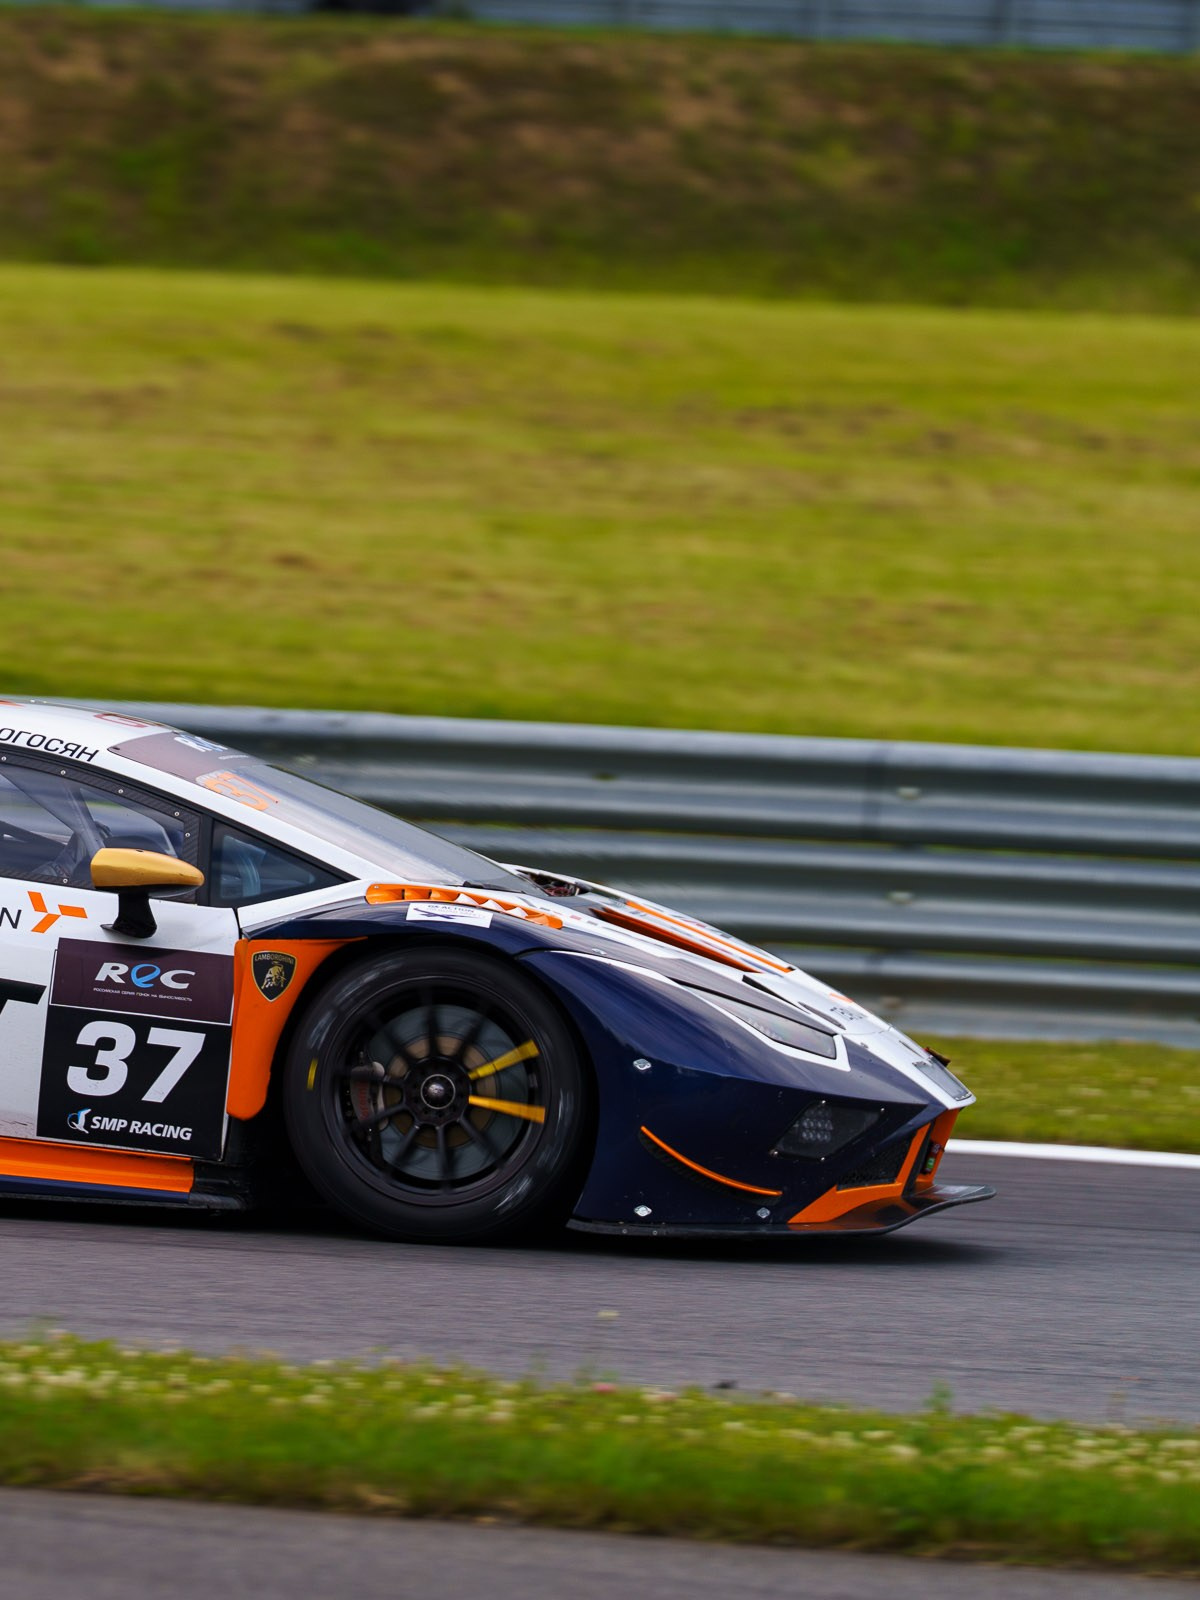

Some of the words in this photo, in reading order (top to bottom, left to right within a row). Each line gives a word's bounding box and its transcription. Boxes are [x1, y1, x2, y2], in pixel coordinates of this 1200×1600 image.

[66, 1020, 206, 1103] 37
[90, 1116, 127, 1135] SMP
[129, 1120, 192, 1140] RACING
